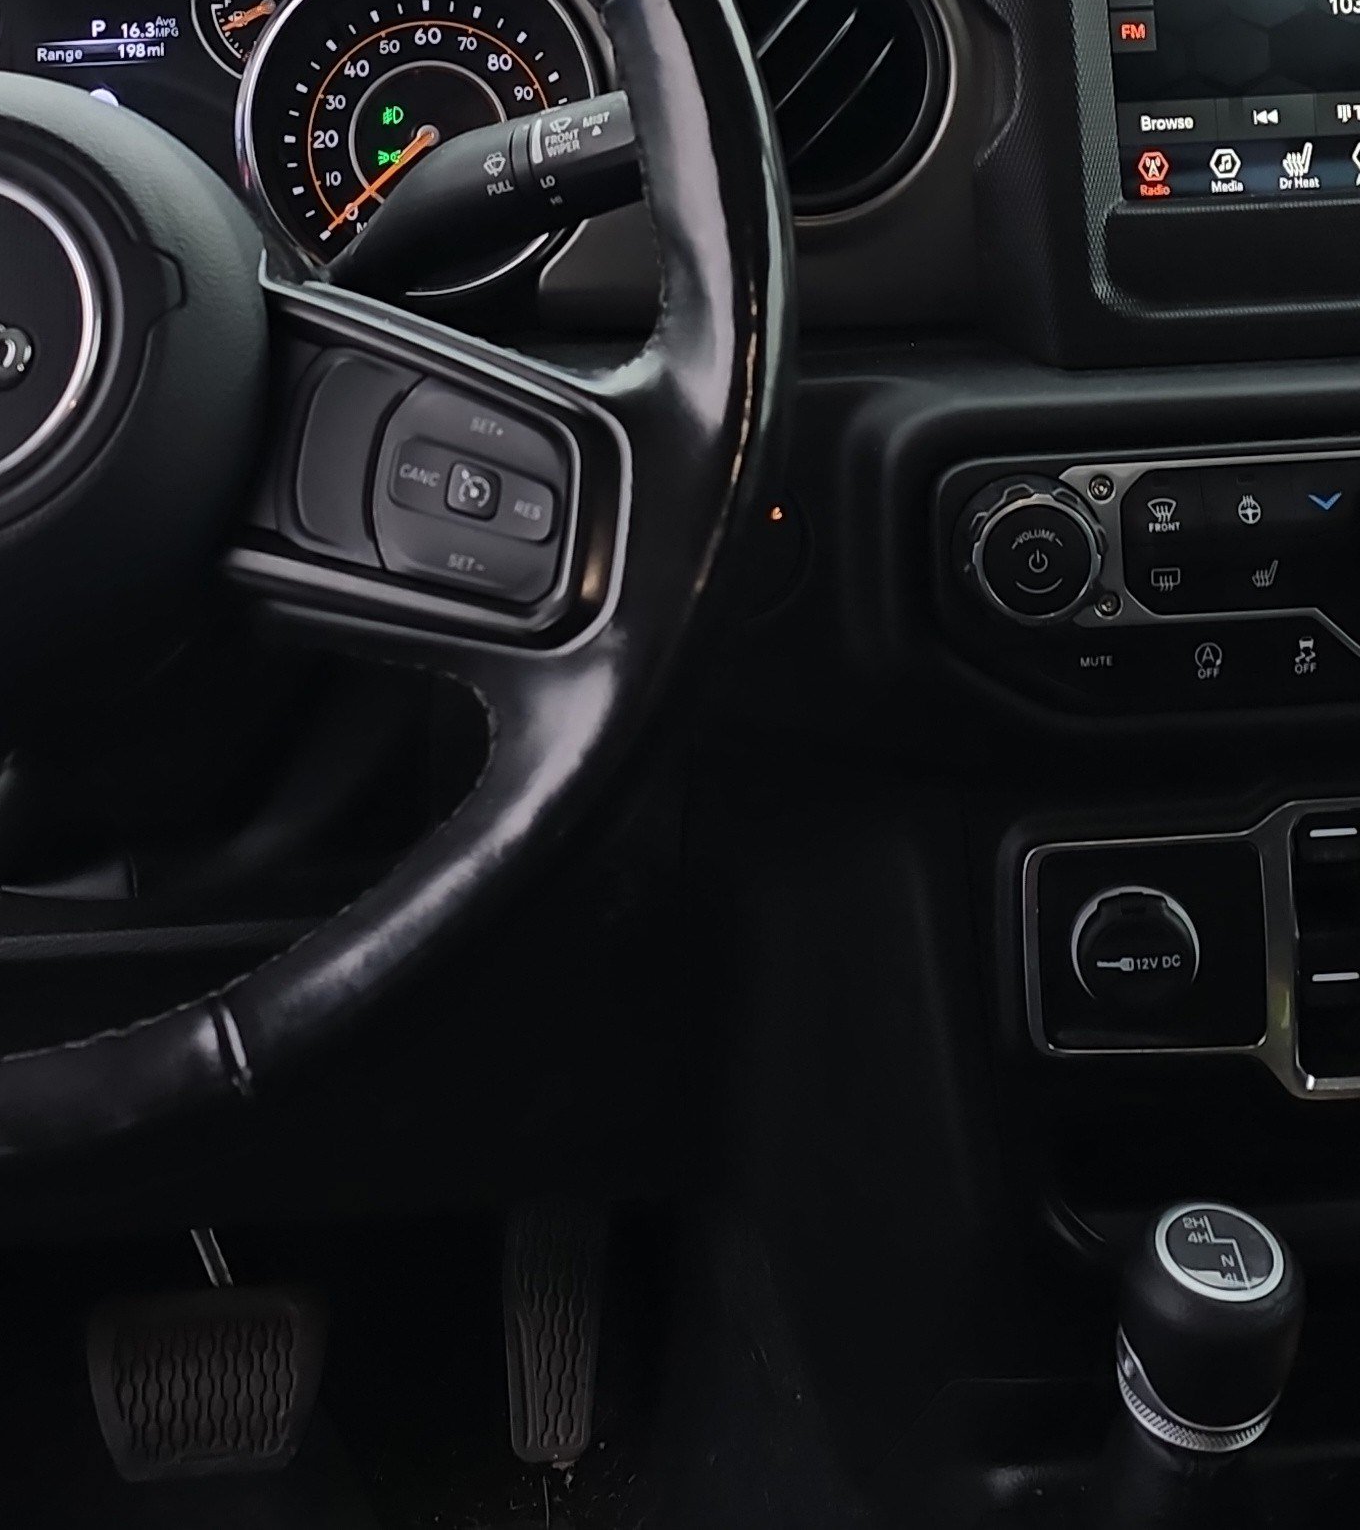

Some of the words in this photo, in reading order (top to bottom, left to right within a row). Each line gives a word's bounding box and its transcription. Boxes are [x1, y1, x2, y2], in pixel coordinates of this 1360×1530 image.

[91, 20, 106, 37] P
[121, 22, 155, 38] 16.3
[155, 16, 176, 28] Avg
[155, 27, 179, 38] MPG
[1121, 24, 1146, 39] FM
[414, 27, 441, 45] 60
[379, 40, 400, 54] 50
[457, 37, 477, 51] 70
[37, 48, 83, 63] Range
[487, 53, 512, 71] 80
[343, 59, 370, 78] 40
[513, 86, 534, 101] 90
[325, 95, 346, 110] 30
[582, 111, 610, 128] MIST
[1140, 115, 1194, 131] Browse
[312, 130, 339, 148] 20
[545, 128, 580, 145] FRONT
[545, 139, 581, 157] WIPER
[326, 171, 341, 186] 10
[540, 175, 556, 189] LO
[1279, 177, 1292, 189] Dr
[1294, 176, 1320, 189] Heat
[486, 179, 514, 196] PULL
[1140, 184, 1170, 196] Radio
[1211, 180, 1244, 193] Media
[1148, 521, 1181, 533] FRONT
[1015, 528, 1058, 545] VOLUME
[1080, 655, 1114, 667] MUTE
[1294, 661, 1318, 674] OFF
[1197, 667, 1221, 680] OFF
[1135, 956, 1158, 972] 12V
[1161, 955, 1181, 969] DC
[1182, 1216, 1205, 1229] 2H
[1187, 1231, 1211, 1243] 4H
[1220, 1254, 1235, 1267] N
